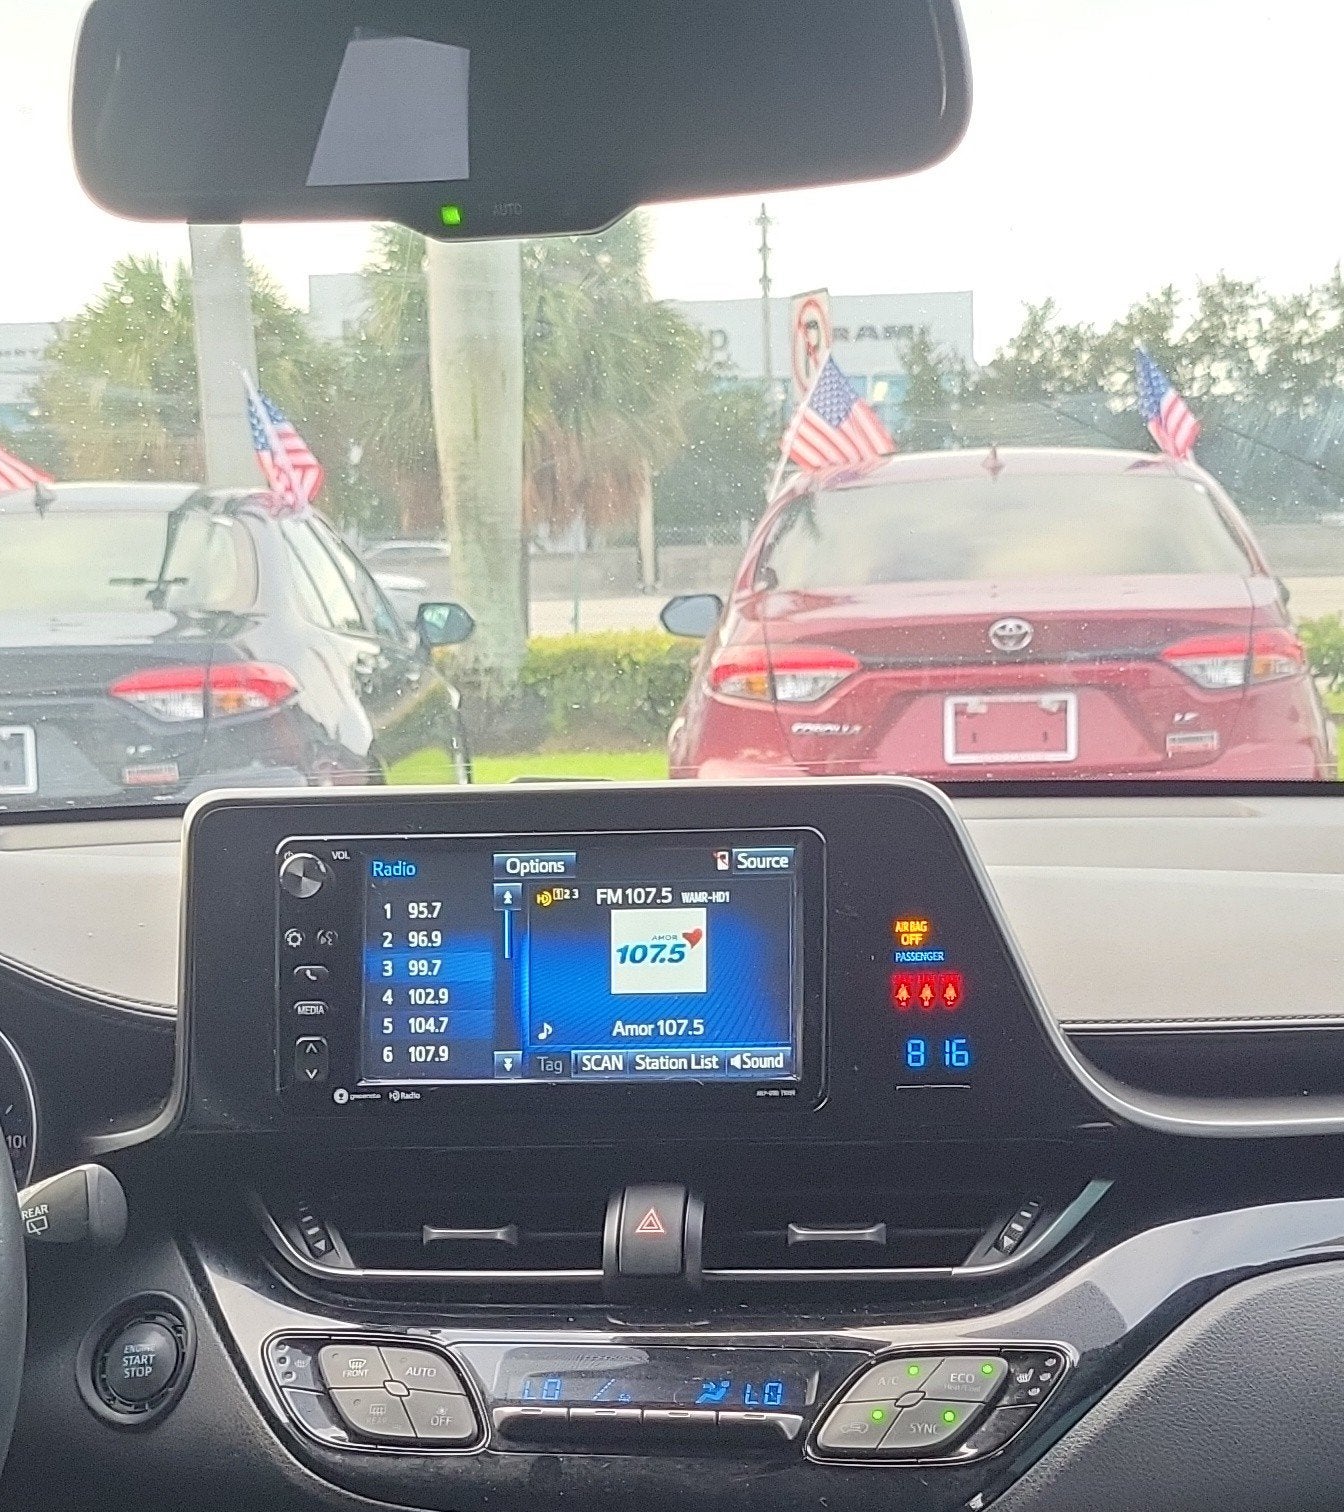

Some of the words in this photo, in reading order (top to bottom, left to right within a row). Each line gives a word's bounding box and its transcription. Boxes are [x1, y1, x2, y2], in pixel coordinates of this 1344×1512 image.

[331, 851, 350, 860] VOL
[737, 853, 789, 869] Source
[373, 861, 416, 876] Radio
[506, 858, 565, 877] Options
[625, 888, 673, 904] 107.5
[682, 891, 730, 904] WAMR-HD1
[384, 903, 391, 919] 1
[408, 902, 442, 919] 95.7
[382, 932, 393, 948] 2
[408, 931, 442, 947] 96.9
[900, 934, 923, 945] OFF
[616, 943, 686, 964] 107.5
[895, 951, 945, 962] PASSENGER
[382, 961, 393, 977] 3
[408, 960, 441, 976] 99.7
[382, 989, 394, 1005] 4
[408, 988, 449, 1005] 102.9
[297, 1006, 325, 1015] MEDIA
[382, 1018, 393, 1034] 5
[408, 1017, 449, 1033] 104.7
[612, 1021, 655, 1037] Amor
[657, 1019, 704, 1035] 107.5
[382, 1047, 393, 1063] 6
[408, 1046, 449, 1062] 107.9
[635, 1054, 688, 1070] Station
[691, 1054, 719, 1070] List
[742, 1053, 784, 1069] Sound
[537, 1056, 563, 1074] Tag
[582, 1055, 623, 1071] SCAN
[21, 1204, 49, 1221] REAR
[123, 1355, 155, 1367] START
[124, 1367, 153, 1378] STOP
[342, 1369, 369, 1378] FRONT
[406, 1366, 437, 1377] AUTO
[950, 1373, 975, 1383] ECO
[877, 1376, 899, 1386] A/C
[431, 1415, 454, 1426] OFF
